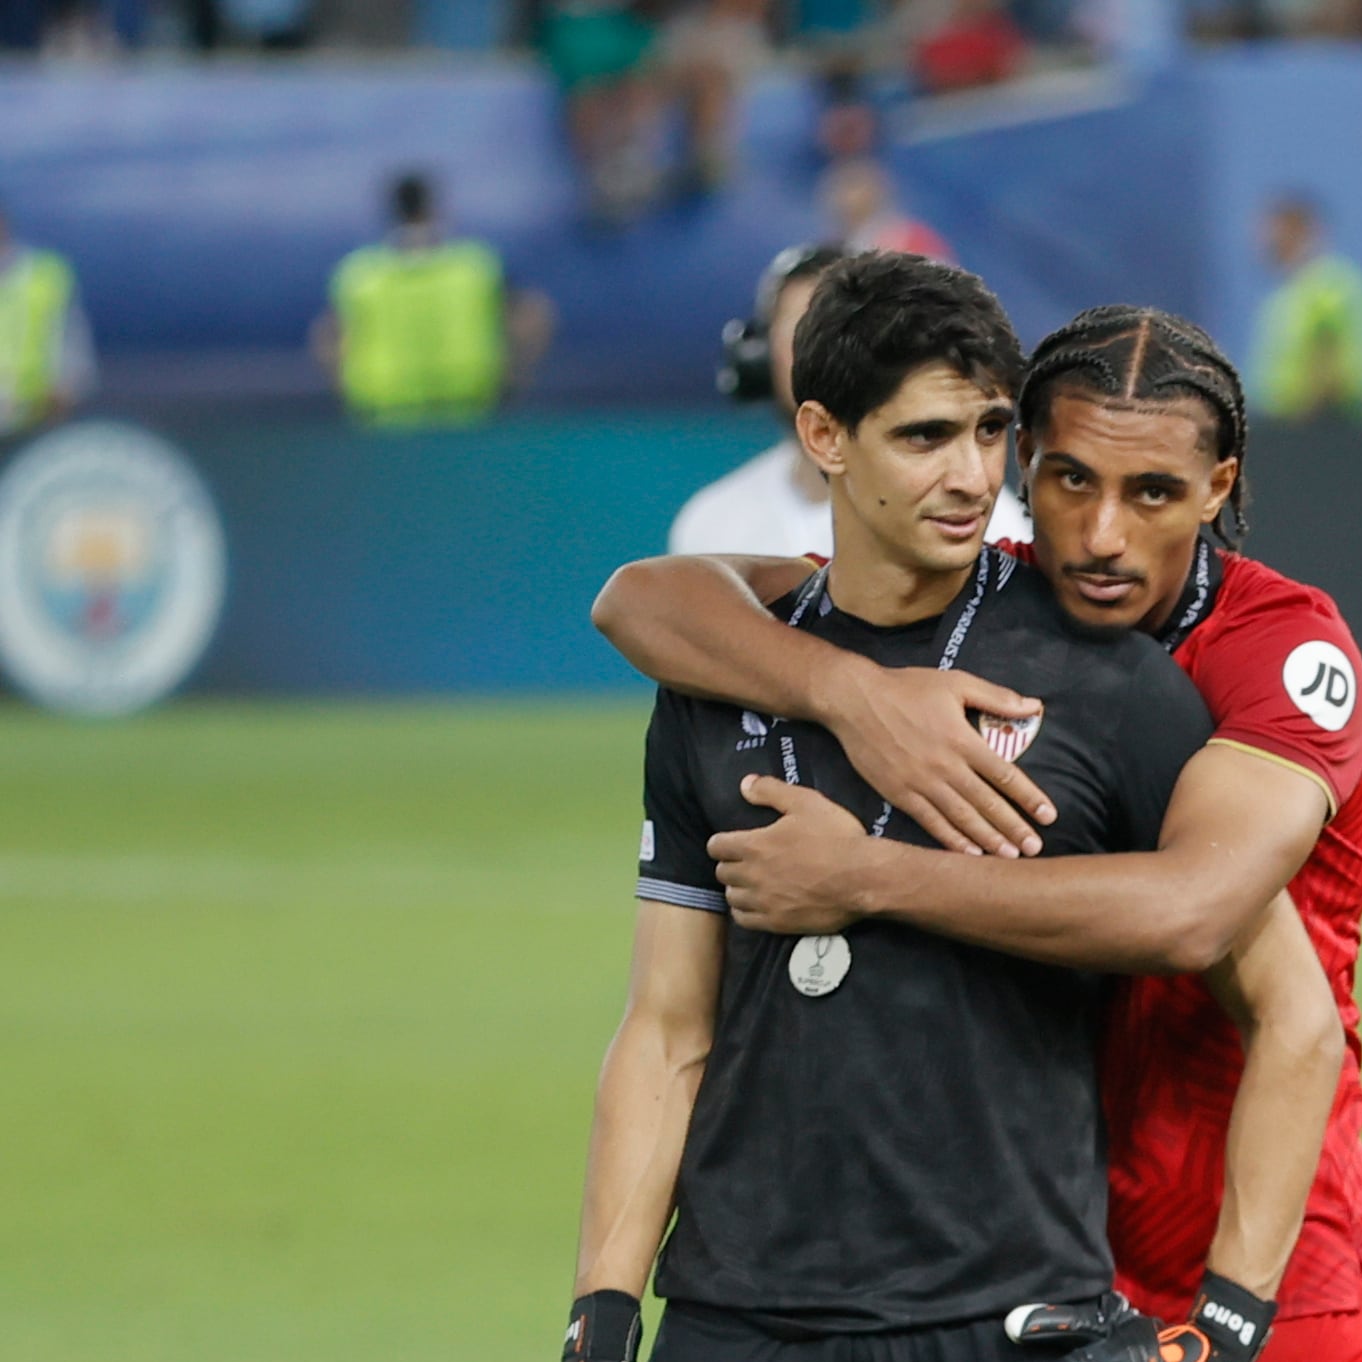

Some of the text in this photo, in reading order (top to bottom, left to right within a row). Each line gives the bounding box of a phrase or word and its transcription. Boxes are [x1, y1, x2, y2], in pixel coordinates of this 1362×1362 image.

[942, 603, 977, 658] PIRAEUS
[1300, 661, 1350, 708] JD
[780, 736, 800, 785] ATHENS
[1203, 1301, 1256, 1346] Bono
